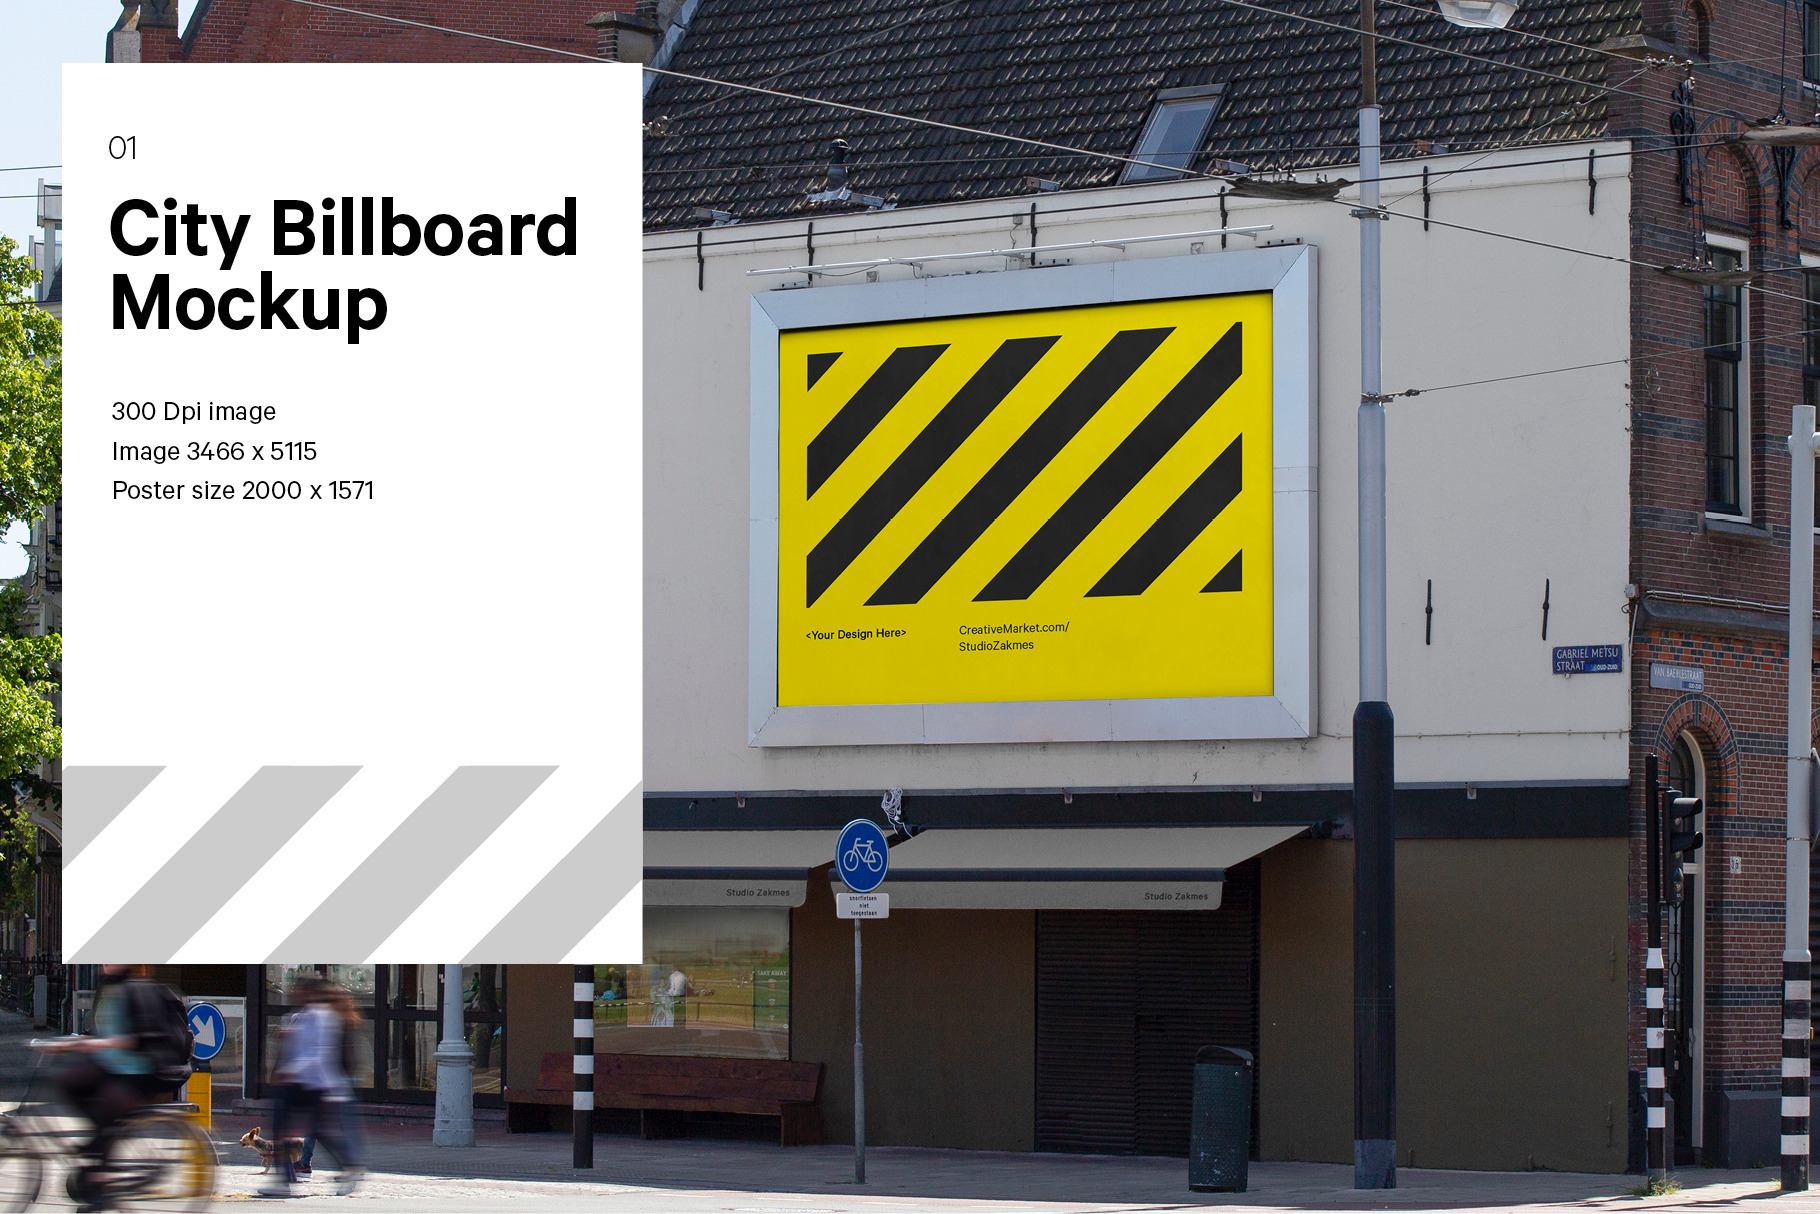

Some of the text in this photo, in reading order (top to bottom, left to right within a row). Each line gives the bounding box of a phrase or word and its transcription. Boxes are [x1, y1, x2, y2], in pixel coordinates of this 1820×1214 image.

[805, 628, 907, 641] <Your Design Here>
[958, 621, 1070, 636] CreativeMarket.com/
[958, 640, 1035, 652] StudioZakmes
[1556, 647, 1619, 659] GABRIEL METSU
[1556, 660, 1586, 672] STRAAT
[1596, 663, 1618, 671] OUD-ZUID
[1653, 666, 1703, 681] VAN BAERLESTRAAT
[726, 888, 791, 897] Studio Zakmes
[1144, 892, 1209, 901] Studio Zakmes
